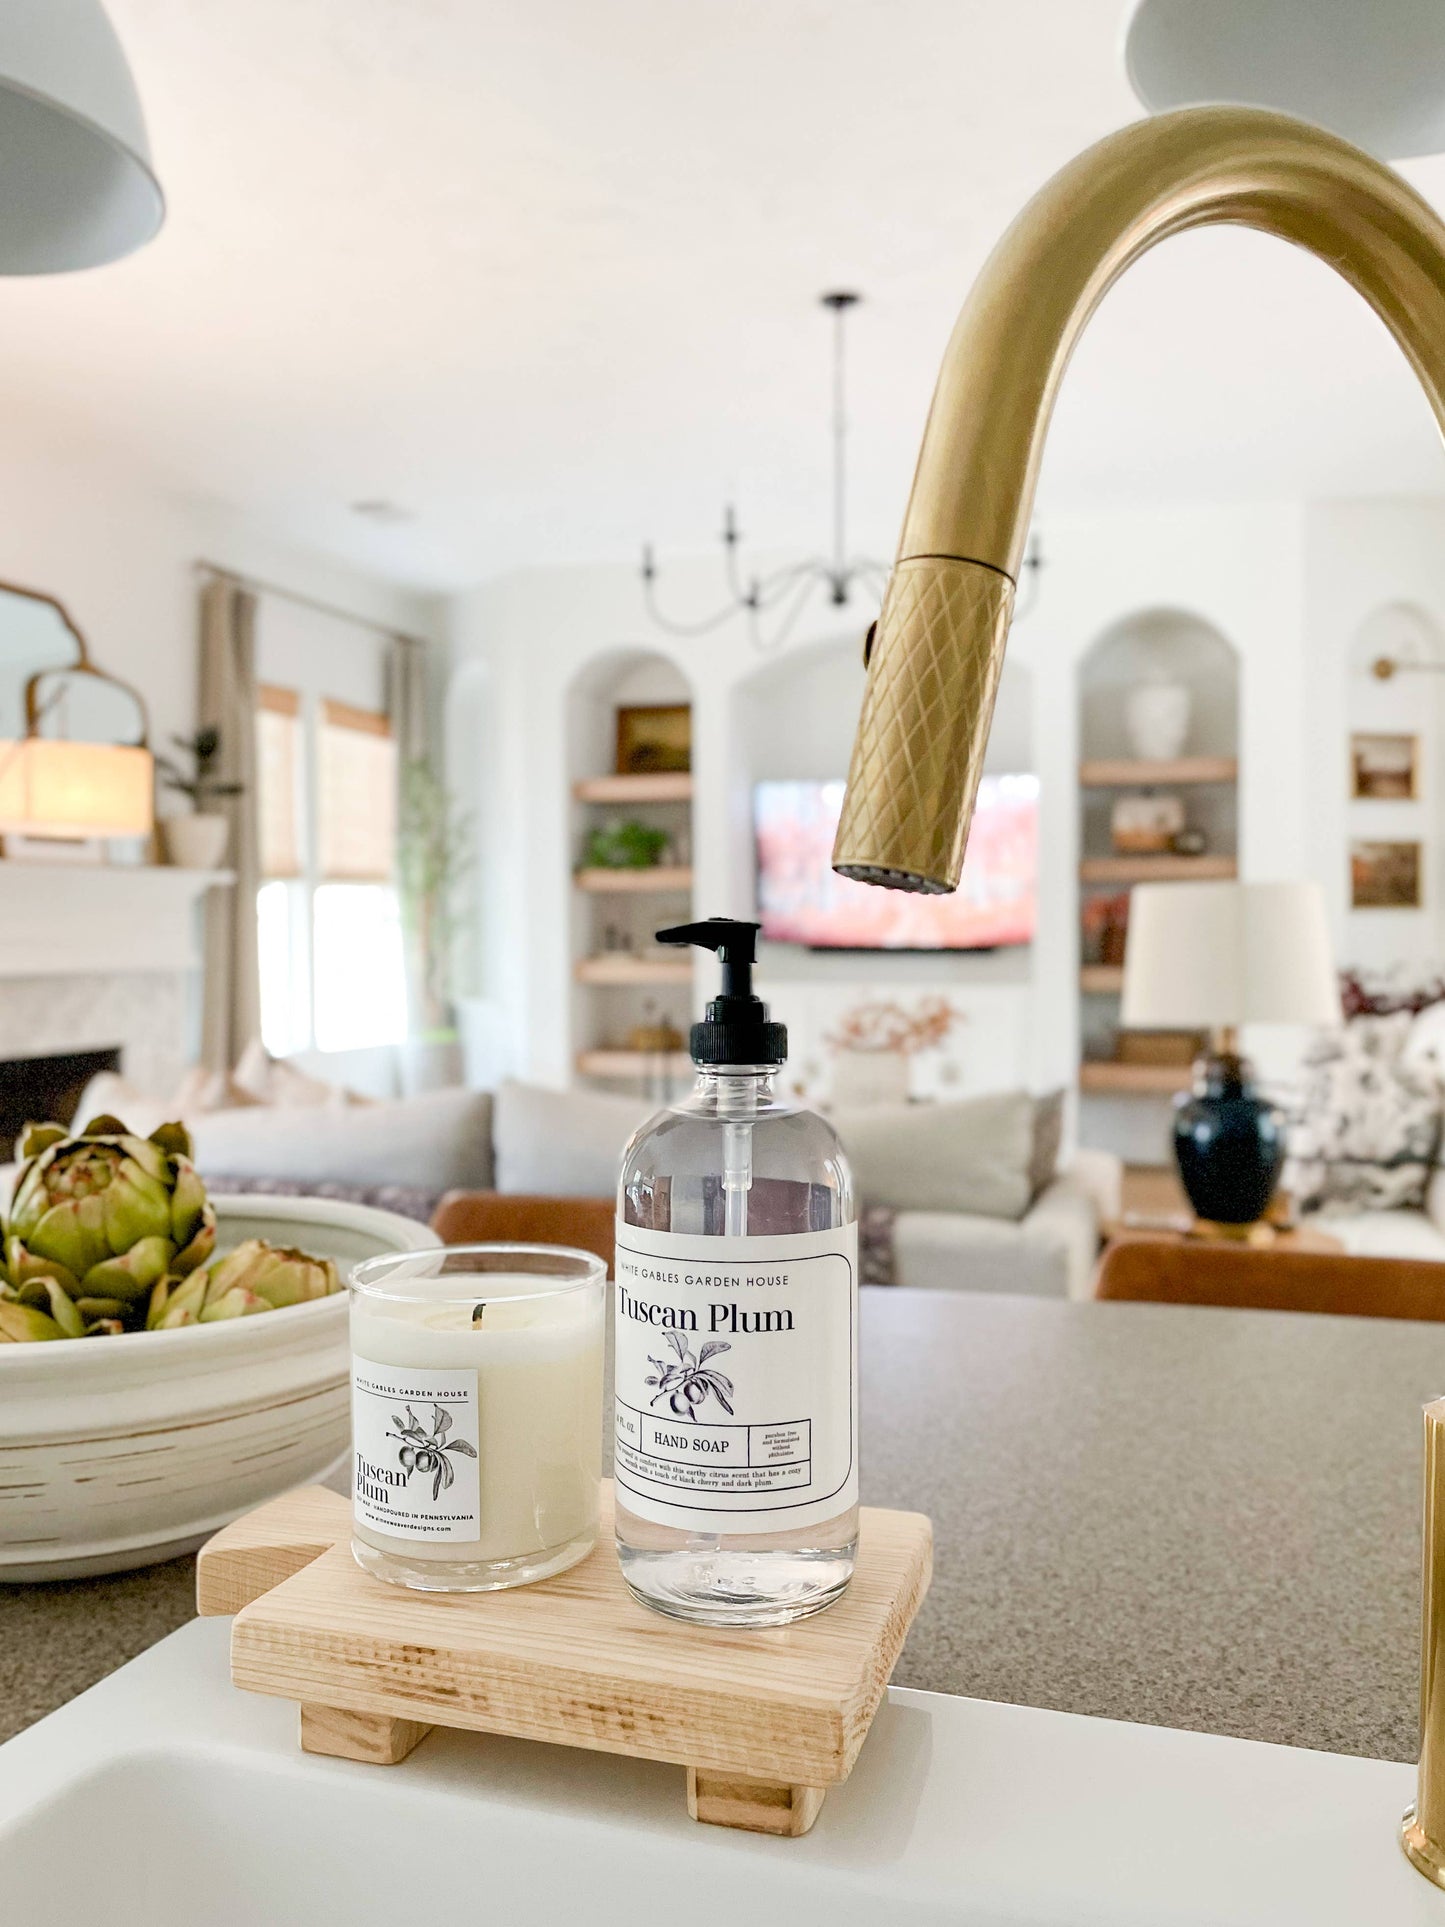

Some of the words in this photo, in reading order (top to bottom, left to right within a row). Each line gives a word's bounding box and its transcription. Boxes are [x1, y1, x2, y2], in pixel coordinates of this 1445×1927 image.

[642, 1268, 679, 1284] GABLES
[685, 1275, 740, 1287] GARDEN
[746, 1275, 789, 1287] HOUSE
[619, 1286, 699, 1331] Tuscan
[707, 1303, 795, 1333] Plum
[372, 1383, 396, 1393] GABLES
[399, 1388, 433, 1397] GARDEN
[654, 1431, 688, 1449] HAND
[692, 1438, 730, 1453] SOAP
[357, 1452, 408, 1487] Tuscan
[686, 1469, 706, 1478] earthy
[709, 1471, 729, 1479] citrus
[788, 1467, 801, 1475] cozy
[357, 1472, 389, 1504] Plum
[697, 1478, 718, 1487] cherry
[420, 1513, 474, 1521] PENNSYLVANIA
